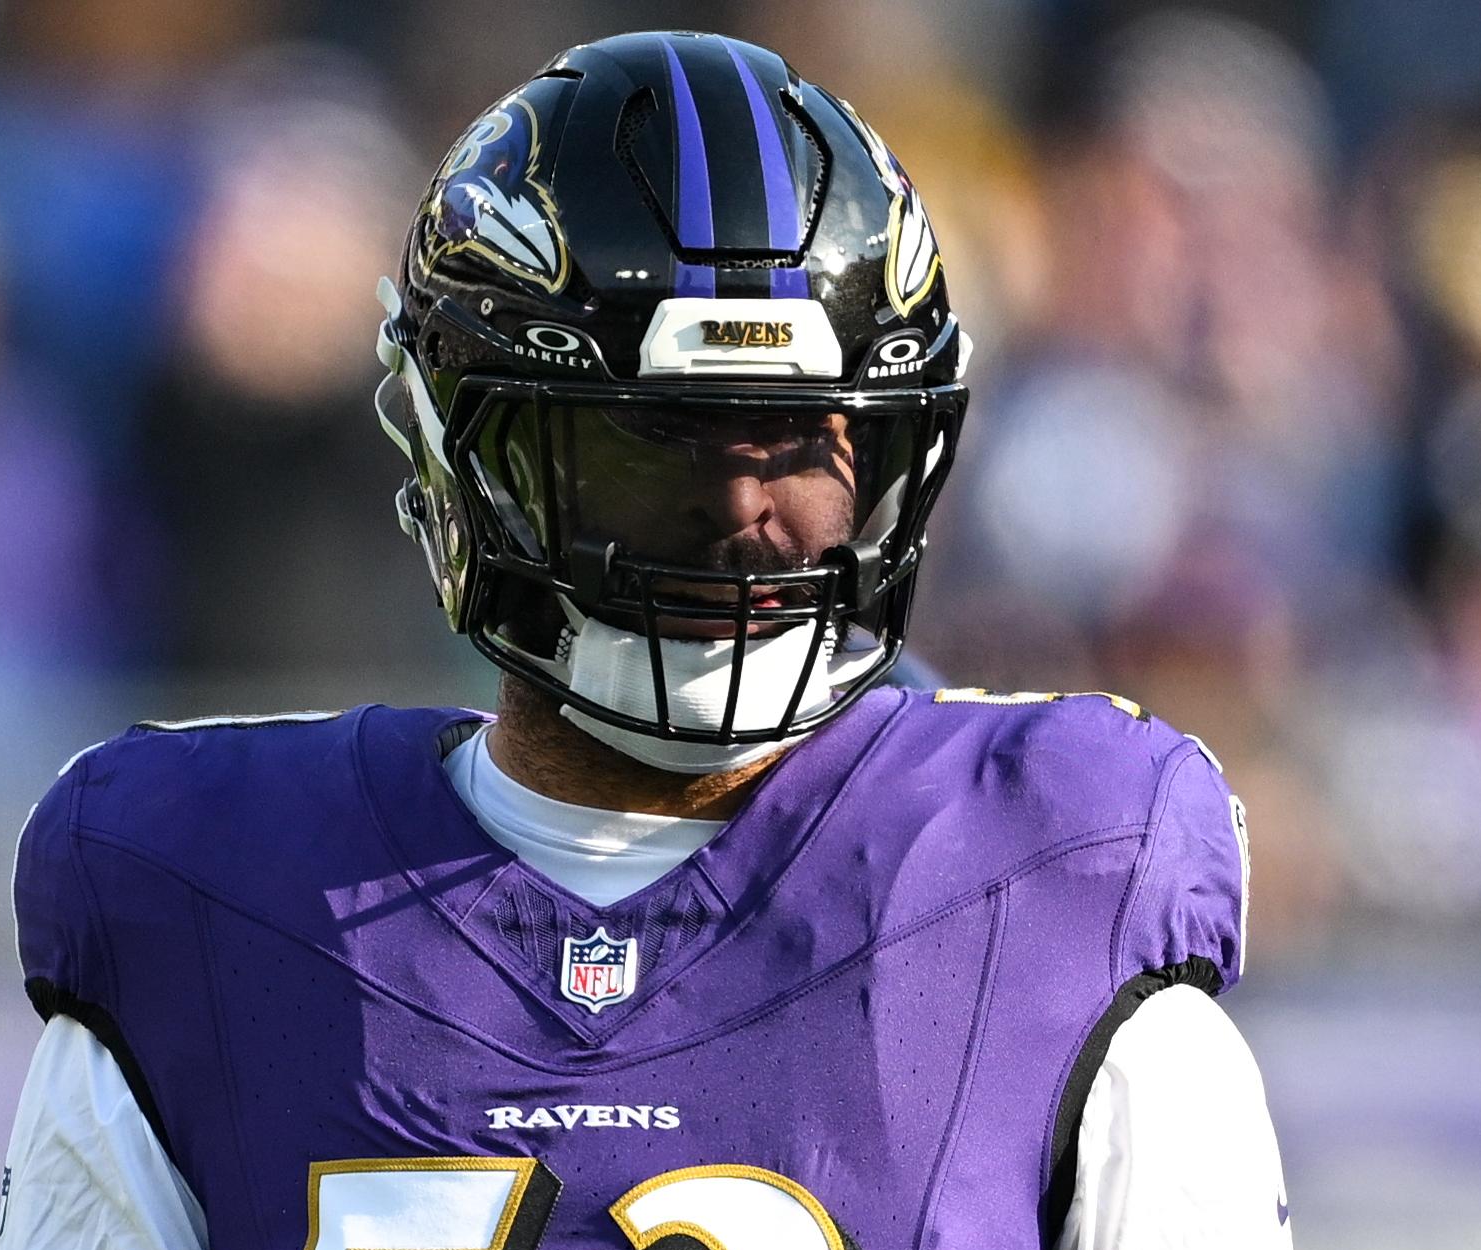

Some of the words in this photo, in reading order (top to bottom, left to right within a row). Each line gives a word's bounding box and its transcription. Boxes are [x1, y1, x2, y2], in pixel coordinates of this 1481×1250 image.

[700, 319, 794, 347] RAVENS
[514, 344, 592, 369] OAKLEY
[572, 965, 618, 997] NFL
[484, 1104, 681, 1130] RAVENS
